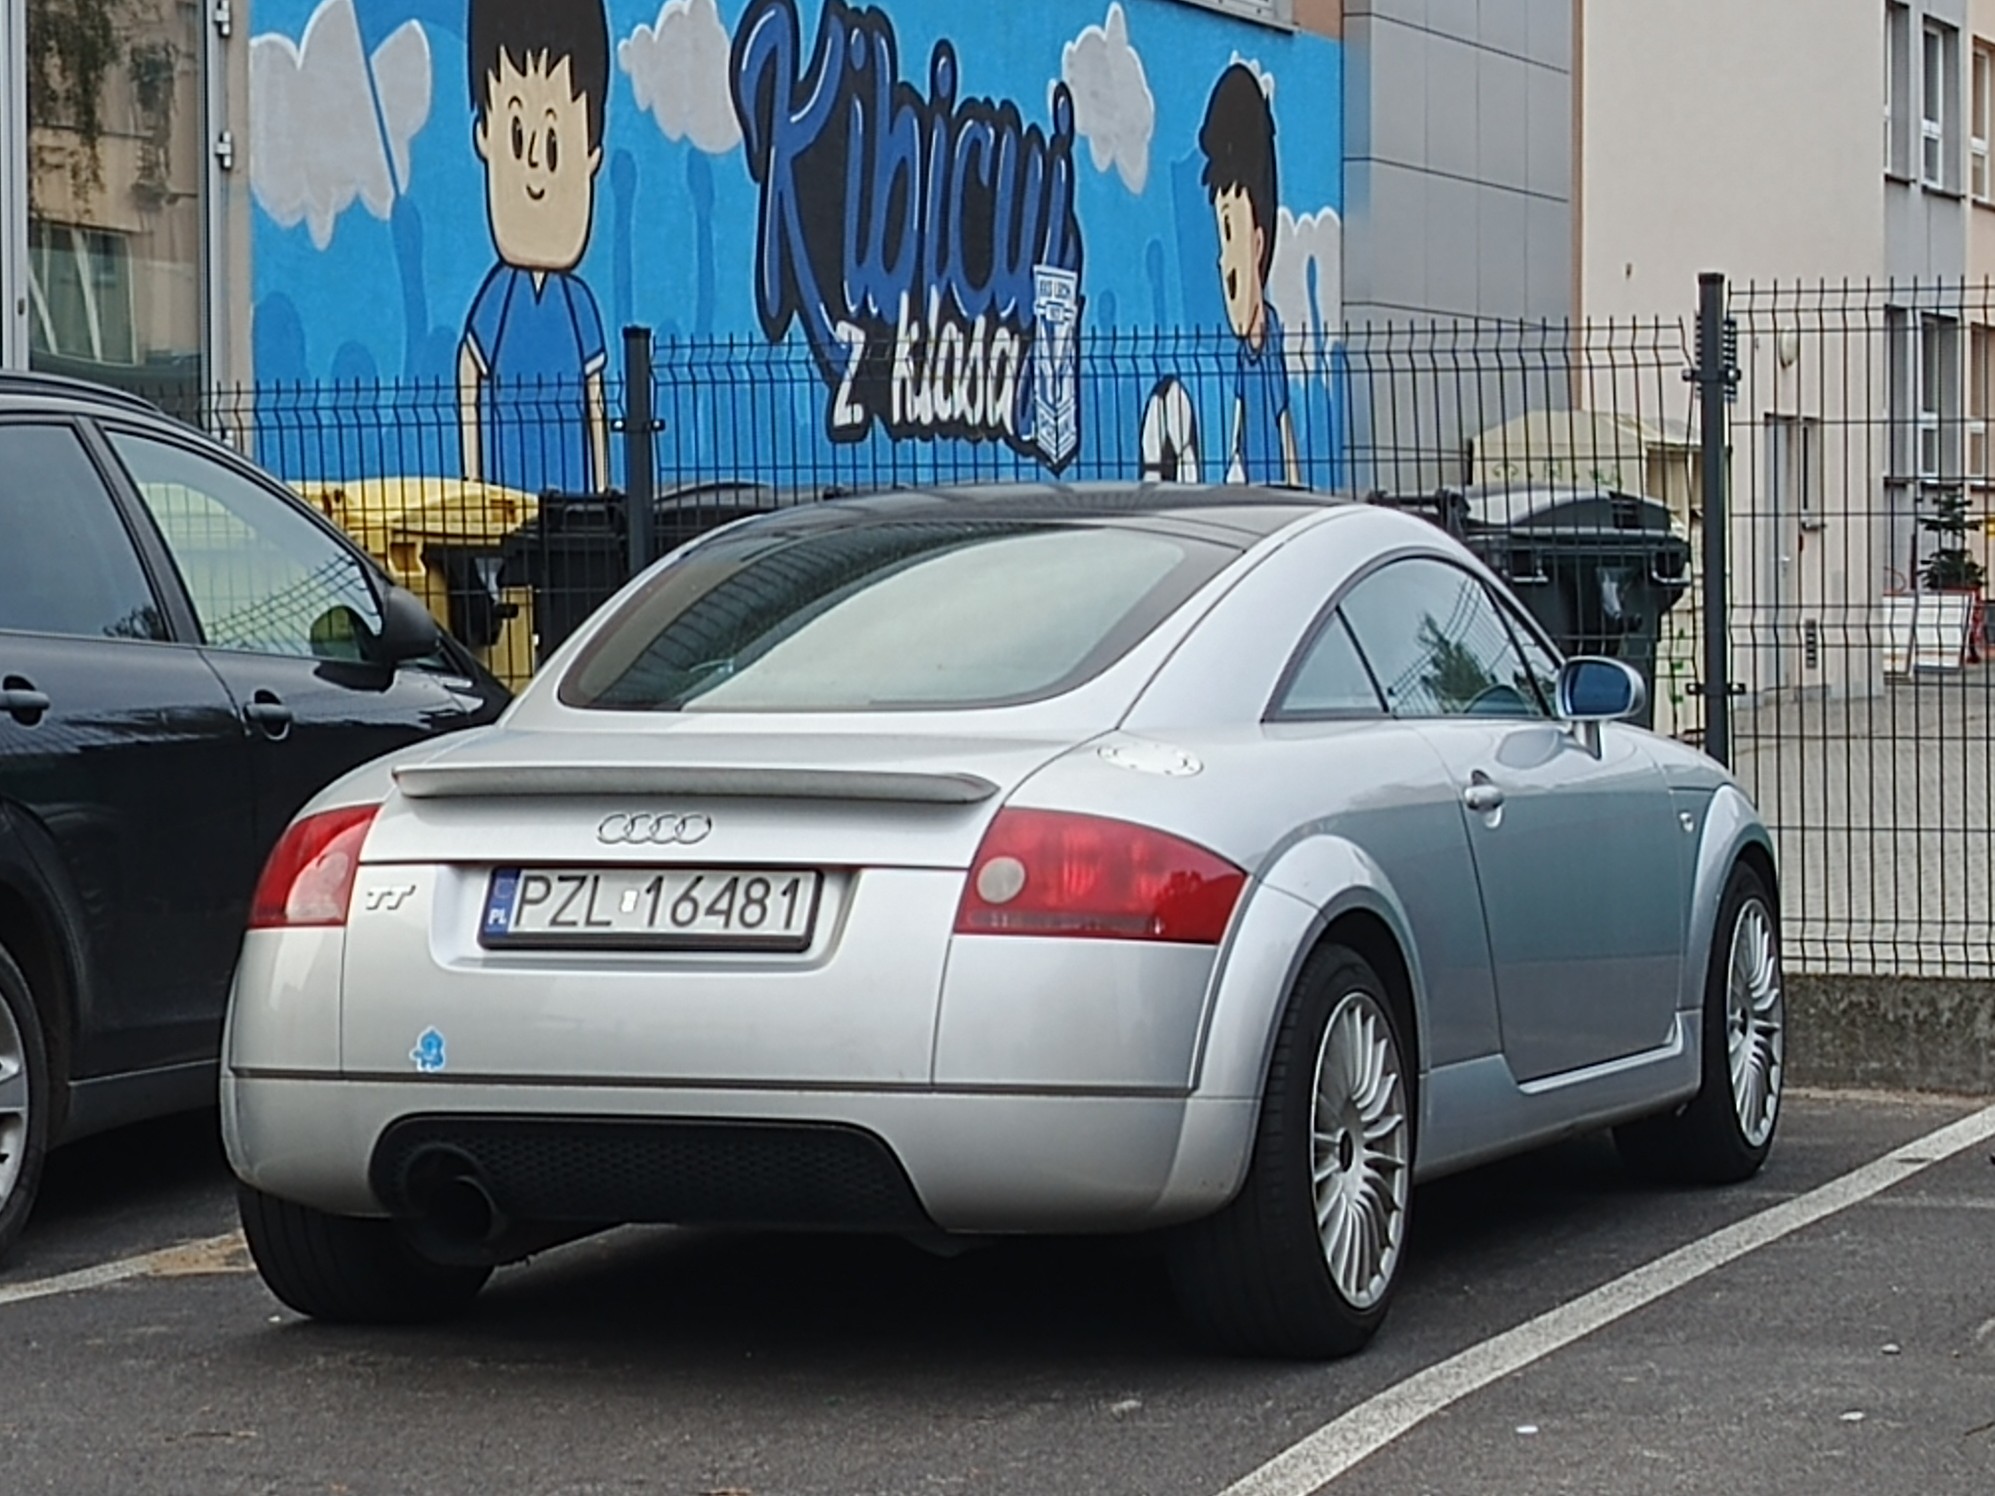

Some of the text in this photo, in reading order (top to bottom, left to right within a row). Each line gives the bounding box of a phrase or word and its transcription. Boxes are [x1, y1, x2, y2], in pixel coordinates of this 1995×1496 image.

[366, 884, 416, 911] TT
[514, 874, 801, 931] PZL 16481
[487, 908, 508, 925] PL
